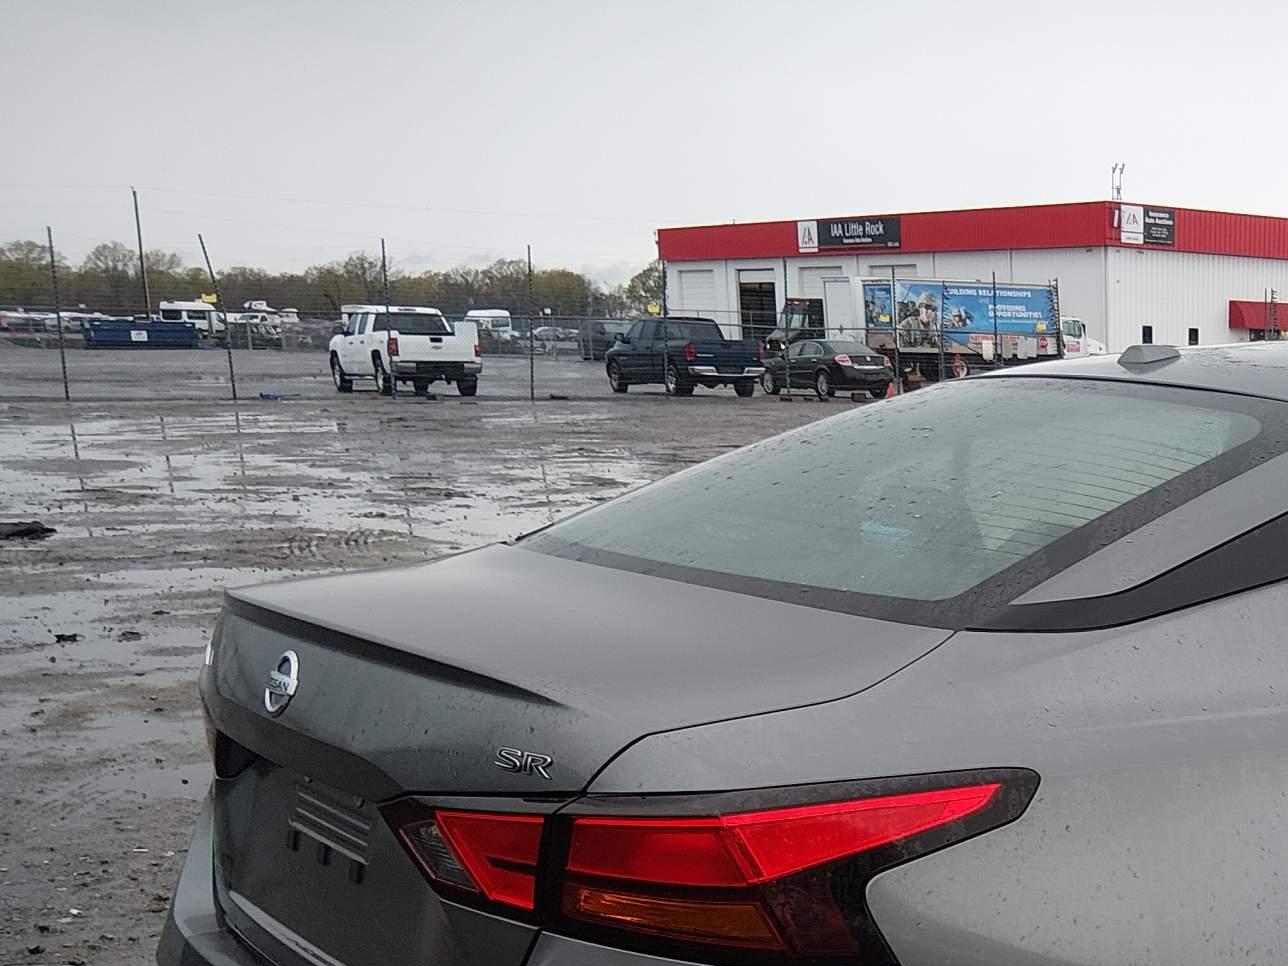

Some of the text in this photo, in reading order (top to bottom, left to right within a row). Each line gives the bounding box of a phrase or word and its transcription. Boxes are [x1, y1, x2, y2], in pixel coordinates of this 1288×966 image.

[830, 223, 843, 237] IAA
[844, 222, 864, 237] Little
[865, 220, 885, 236] Rock
[494, 746, 553, 780] SR
